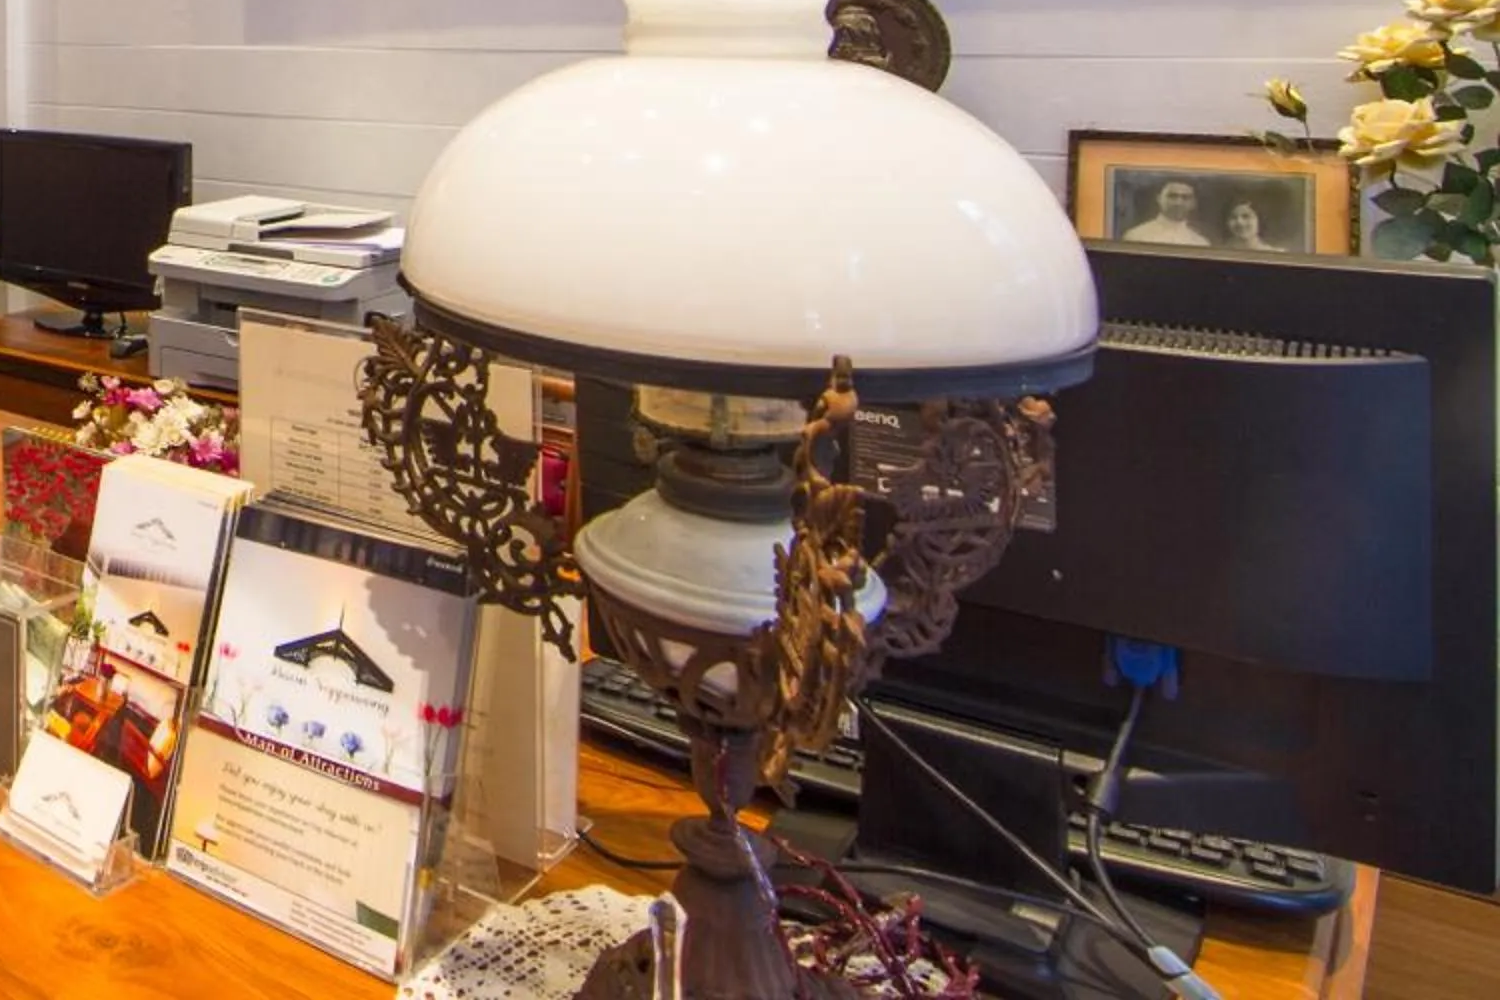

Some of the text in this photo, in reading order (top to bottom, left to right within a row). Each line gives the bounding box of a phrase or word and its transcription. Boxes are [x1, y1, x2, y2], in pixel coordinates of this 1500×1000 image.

[245, 732, 381, 791] Map of Attractions
